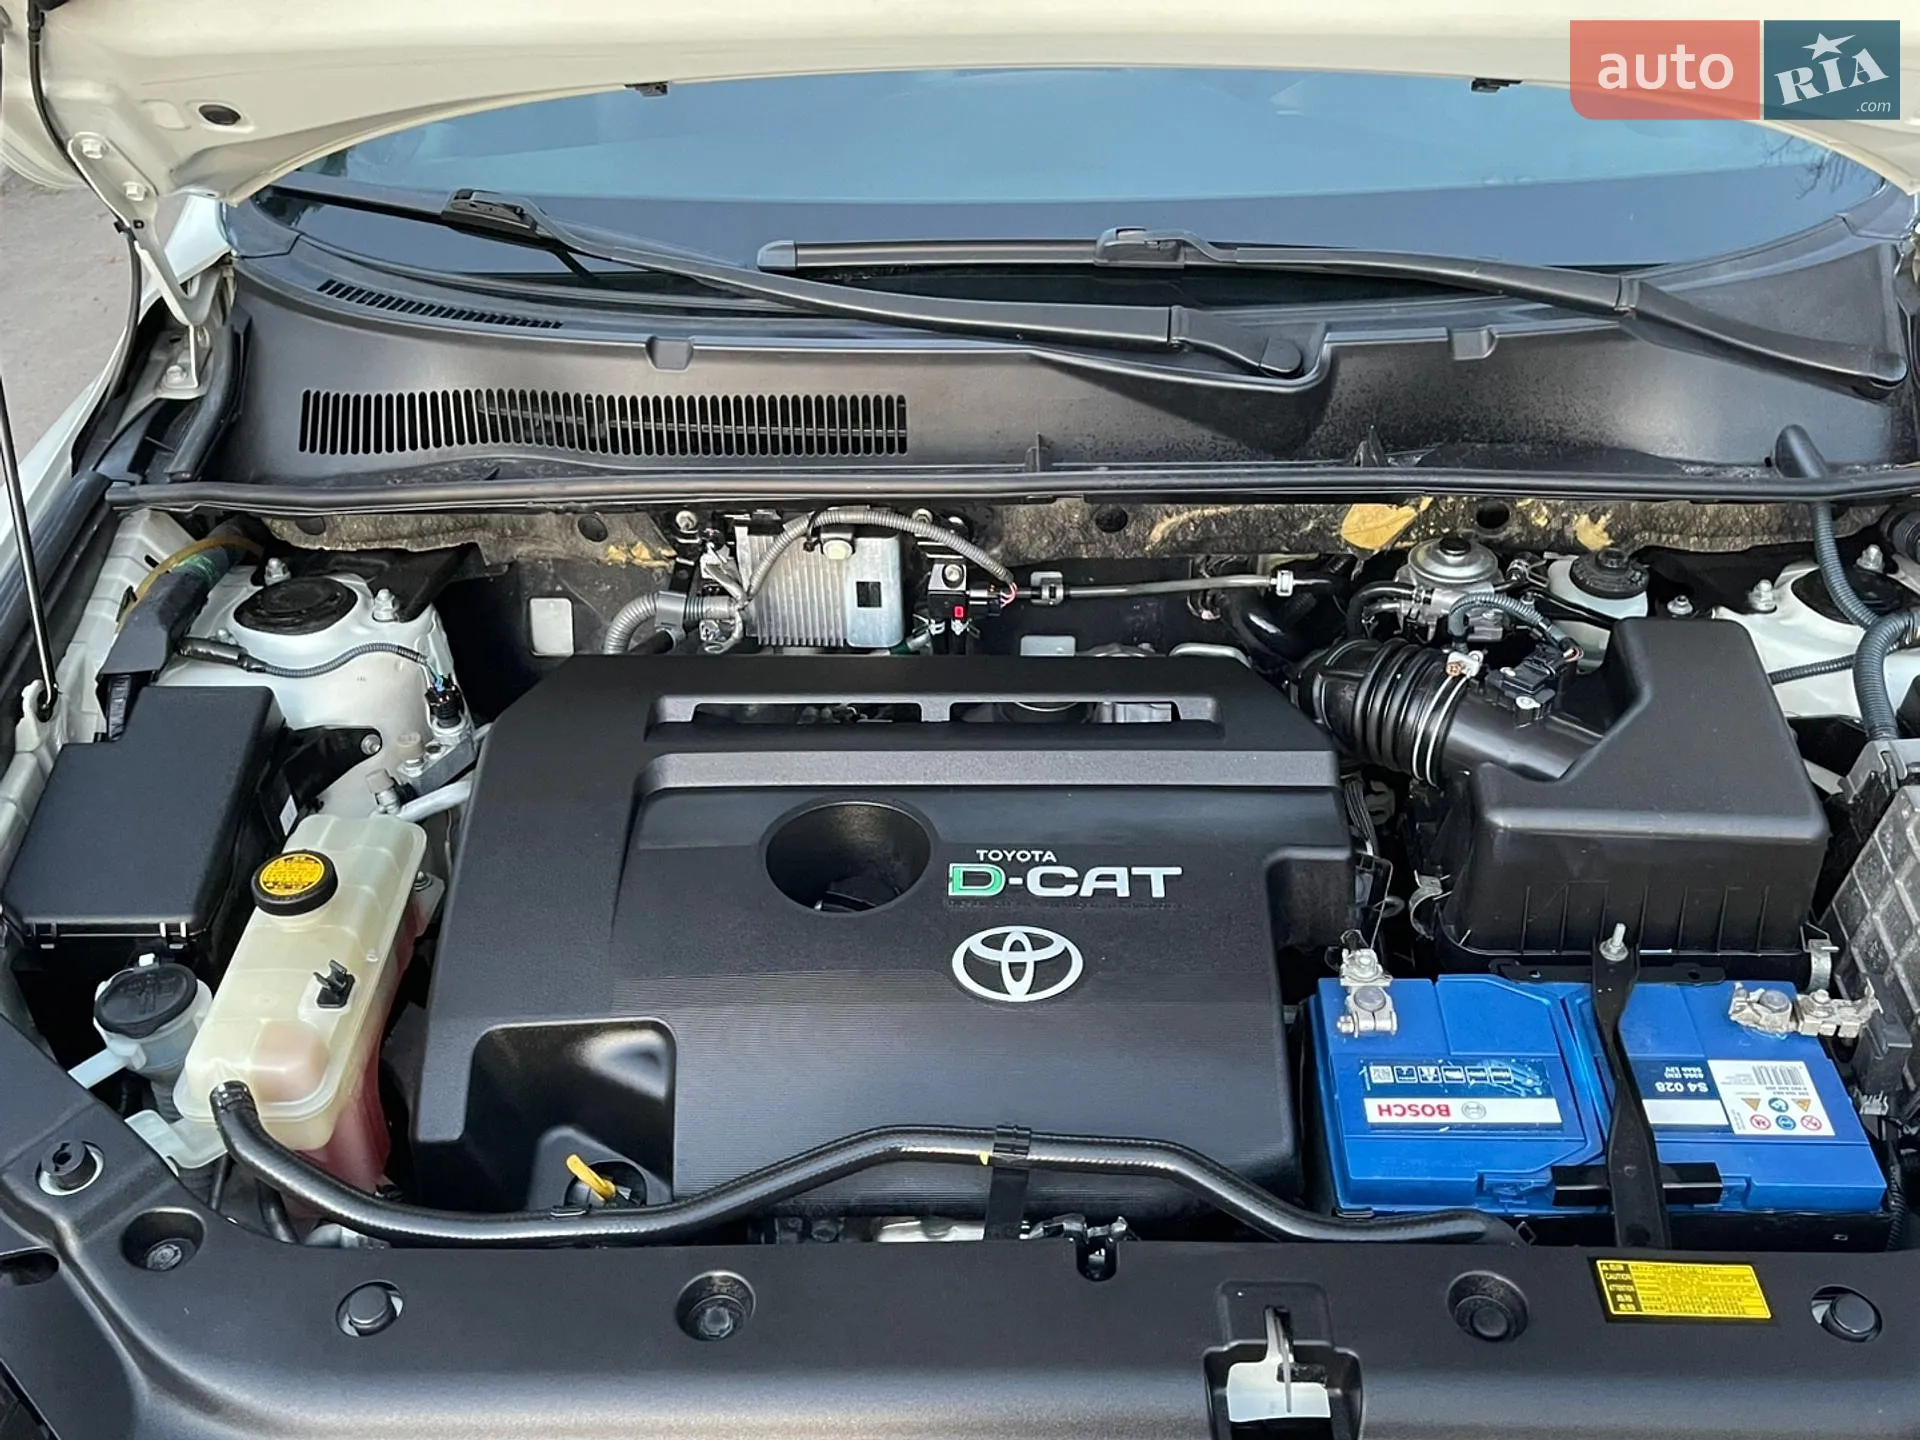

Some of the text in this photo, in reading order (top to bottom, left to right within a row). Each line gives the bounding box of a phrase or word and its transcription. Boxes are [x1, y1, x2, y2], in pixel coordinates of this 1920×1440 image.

[976, 850, 1057, 862] TOYOTA
[948, 863, 1183, 898] D-CAT
[1654, 1082, 1708, 1093] S4 028
[1377, 1103, 1452, 1118] BOSCH
